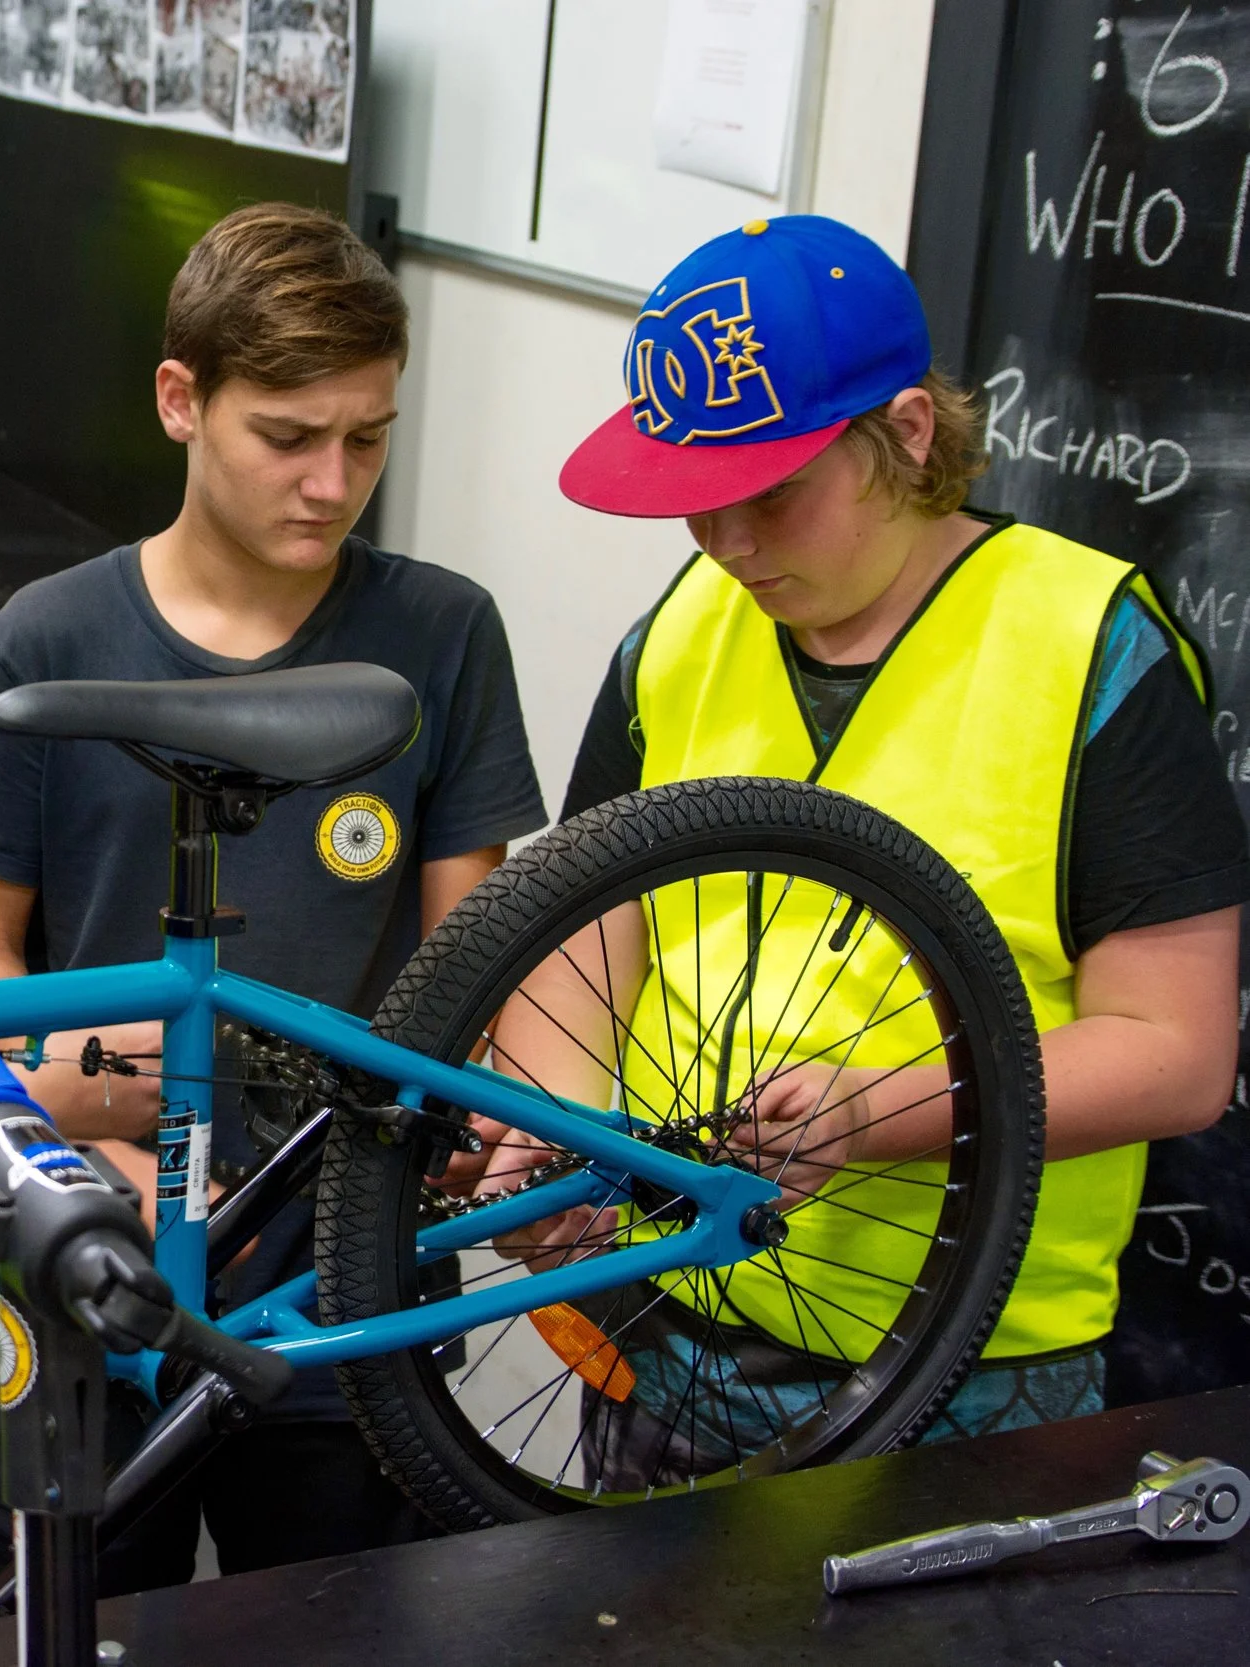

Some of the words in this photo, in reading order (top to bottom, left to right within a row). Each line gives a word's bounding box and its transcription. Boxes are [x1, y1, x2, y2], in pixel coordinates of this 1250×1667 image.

[1025, 130, 1185, 266] WHO
[984, 367, 1191, 504] RICHARD
[337, 798, 382, 814] TRACTION
[328, 852, 341, 867] BUILD
[341, 863, 356, 873] YOUR
